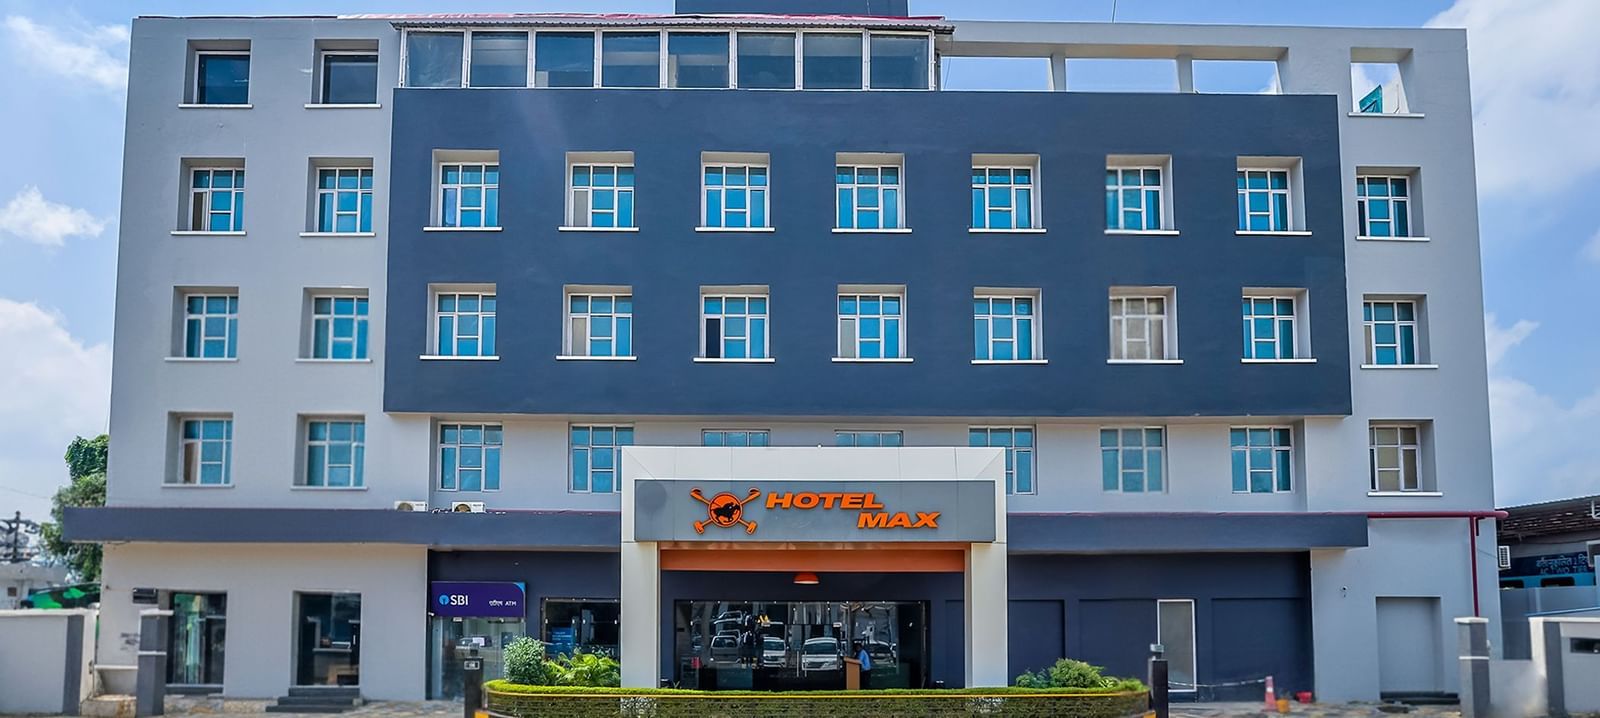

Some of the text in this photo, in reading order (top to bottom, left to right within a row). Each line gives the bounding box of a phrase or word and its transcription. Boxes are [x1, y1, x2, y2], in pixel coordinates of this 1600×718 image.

[766, 492, 884, 509] HOTEL
[857, 511, 941, 529] MAX
[450, 595, 469, 606] SBI
